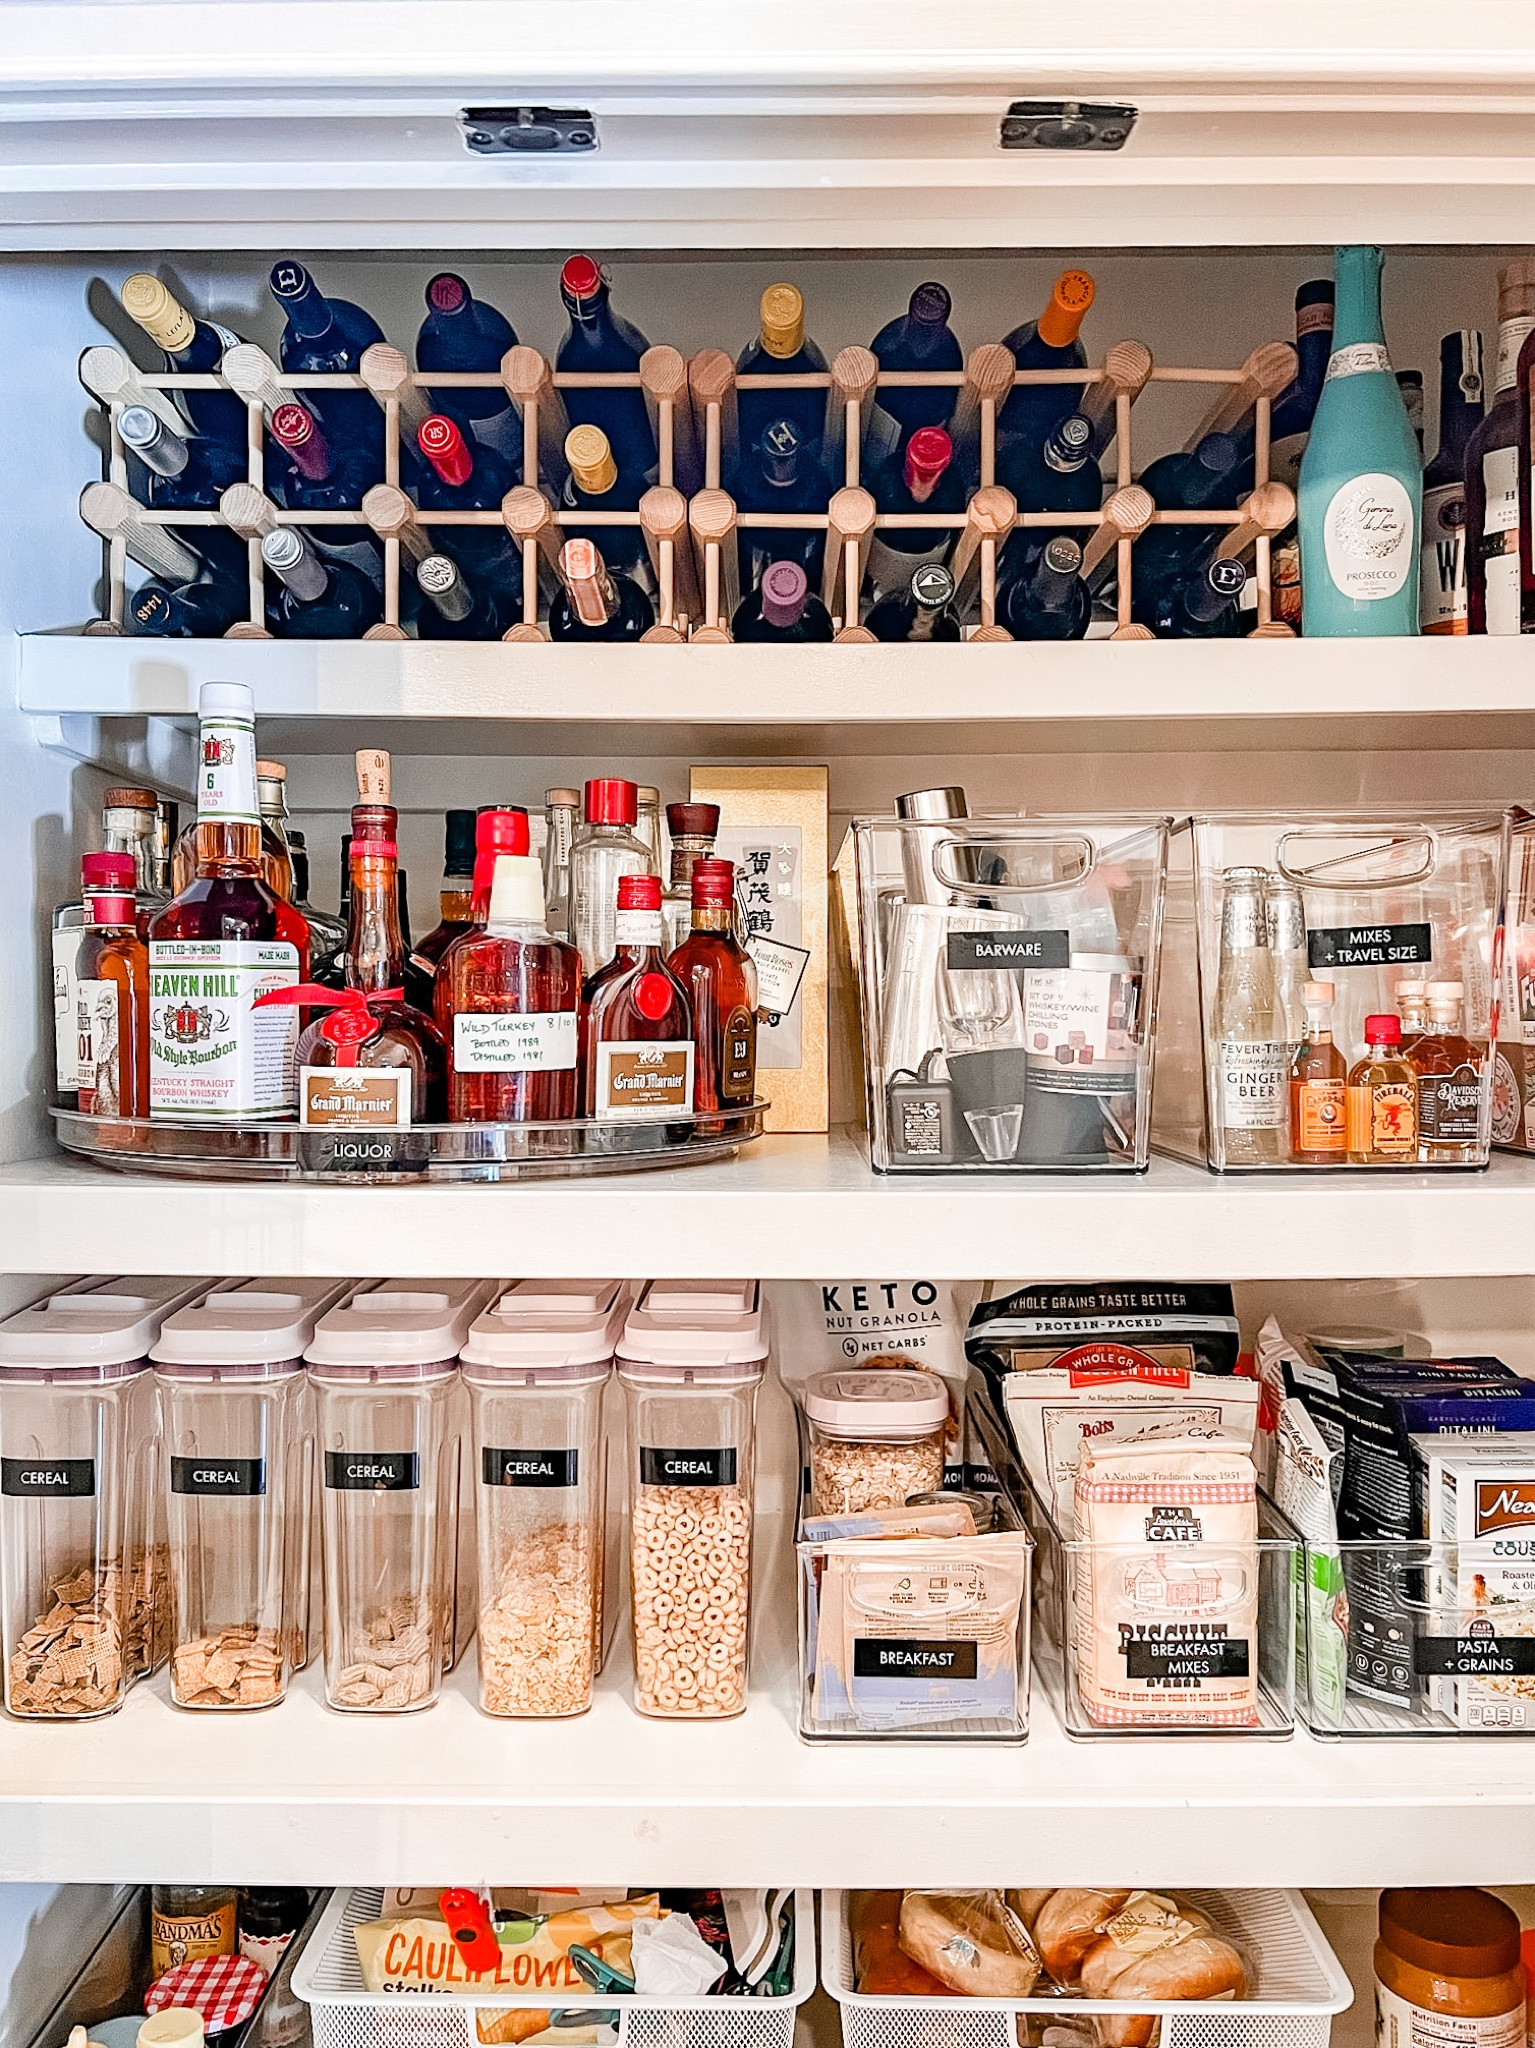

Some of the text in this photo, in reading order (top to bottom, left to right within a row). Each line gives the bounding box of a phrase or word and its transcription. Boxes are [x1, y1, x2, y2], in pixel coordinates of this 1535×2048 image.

[1346, 571, 1397, 581] PROSECCO
[136, 594, 162, 621] 1448
[207, 772, 215, 790] 6
[203, 798, 218, 806] OLD
[1349, 929, 1391, 944] MIXES
[975, 943, 1042, 958] BARWARE
[1325, 946, 1418, 962] + TRAVEL SIZE
[203, 975, 238, 997] HILL
[1028, 1001, 1100, 1014] WHISKEY/WINE
[1028, 1011, 1069, 1021] CHILLING
[461, 1020, 491, 1035] WILD
[491, 1017, 536, 1032] TURKEY
[1027, 1020, 1058, 1030] STONES
[188, 1039, 237, 1066] Bourbon
[190, 1079, 236, 1088] STRAIGHT
[613, 1072, 685, 1090] Grand Marnier
[1227, 1072, 1283, 1084] GINGER
[152, 1087, 230, 1098] BOURBON WHISKEY
[1239, 1085, 1275, 1097] BEER
[1374, 1087, 1414, 1103] FIREBALL
[310, 1093, 394, 1113] Grand Marnier
[1446, 1094, 1483, 1111] RESERVE
[334, 1143, 393, 1158] LIQUOR
[822, 1280, 938, 1312] KETO
[1008, 1293, 1187, 1310] WHOLE GRAINS TASTE BETTER
[826, 1310, 941, 1328] NUT GRANOLA
[1035, 1318, 1163, 1332] PROTEIN-PACKED
[862, 1341, 883, 1352] NET
[1071, 1353, 1115, 1369] WHOLE
[1462, 1389, 1522, 1397] DITALINI
[346, 1464, 395, 1479] CEREAL
[505, 1461, 555, 1476] CEREAL
[664, 1460, 713, 1475] CEREAL
[20, 1471, 69, 1486] CEREAL
[192, 1470, 241, 1484] CEREAL
[1101, 1472, 1110, 1481] A
[1113, 1471, 1150, 1481] Nashville
[1151, 1471, 1190, 1481] Tradition
[1192, 1471, 1216, 1481] Since
[1159, 1508, 1185, 1517] THE
[1149, 1526, 1200, 1541] CAFE
[1511, 1582, 1520, 1590] &
[1151, 1643, 1226, 1657] BREAKFAST
[1457, 1640, 1500, 1654] PASTA
[879, 1650, 955, 1666] BREAKFAST
[1444, 1658, 1514, 1672] + GRAINS
[1168, 1660, 1210, 1675] MIXES
[155, 1917, 222, 1941] RANDMA'S
[384, 1932, 603, 1988] CAULLOWE
[1412, 2010, 1477, 2031] Nutrition Facts
